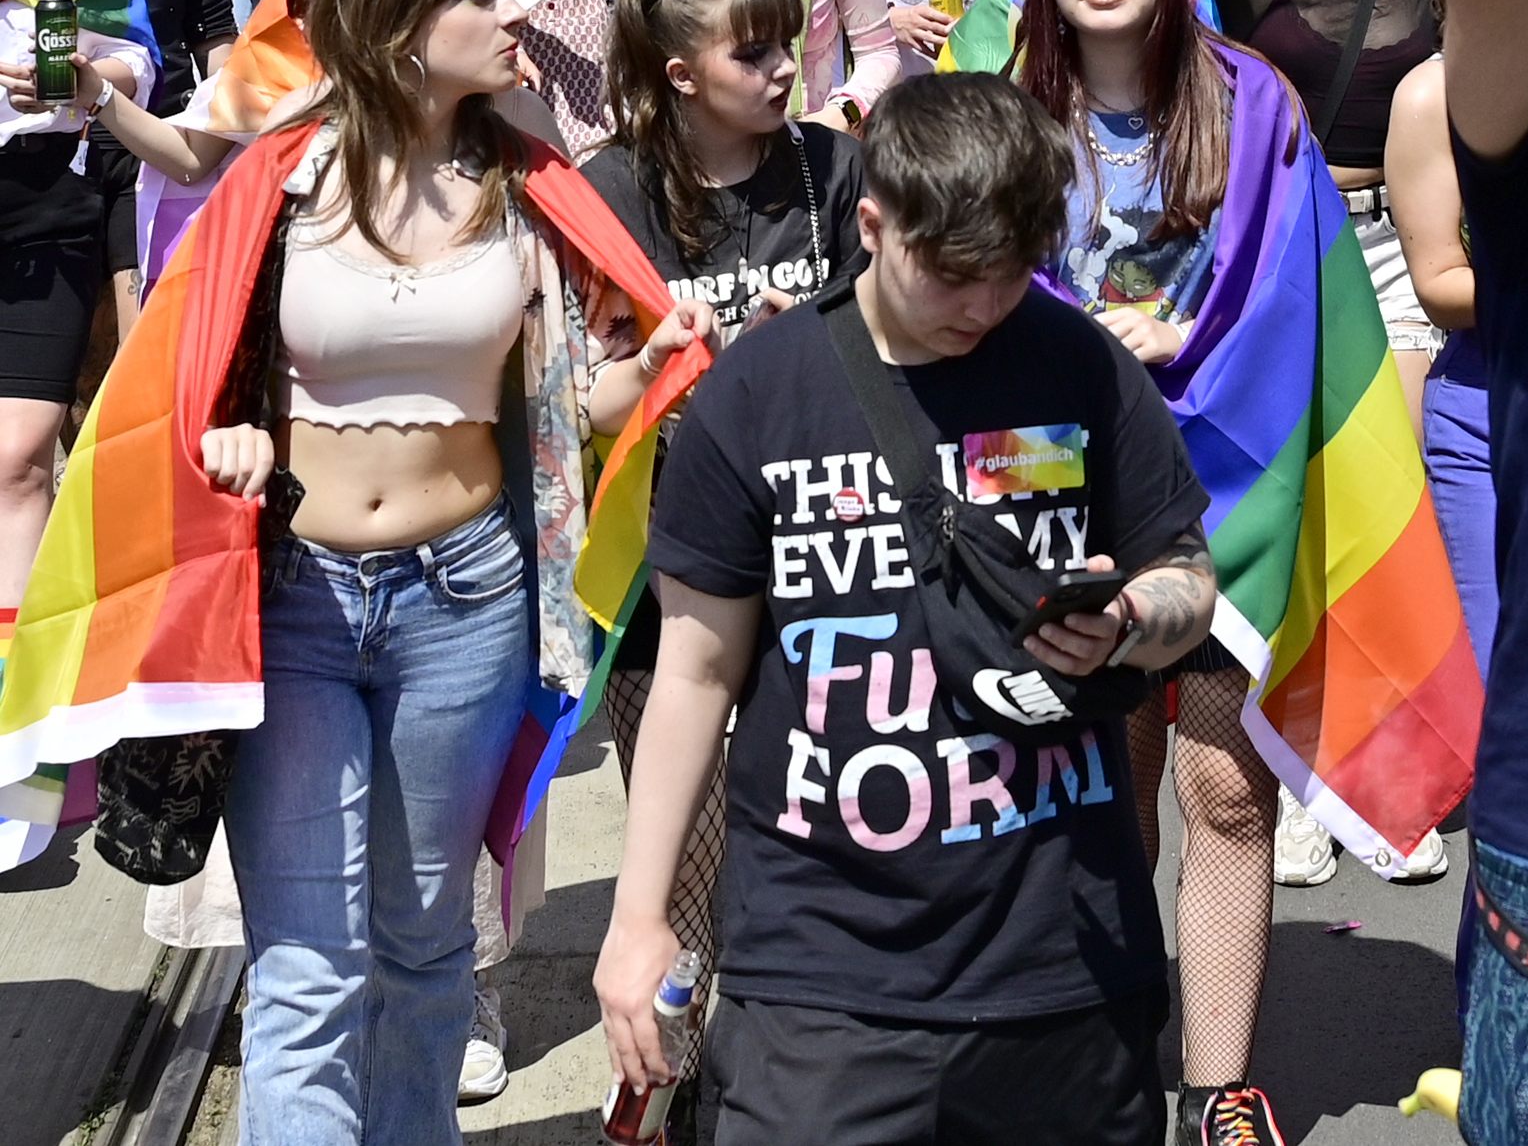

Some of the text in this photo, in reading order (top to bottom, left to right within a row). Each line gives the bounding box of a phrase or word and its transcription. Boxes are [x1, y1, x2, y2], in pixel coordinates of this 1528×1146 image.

[667, 272, 735, 304] URF
[760, 451, 902, 525] THIS
[974, 446, 1075, 473] #glaubandich
[772, 523, 916, 599] EVE
[776, 727, 1113, 853] FORM
